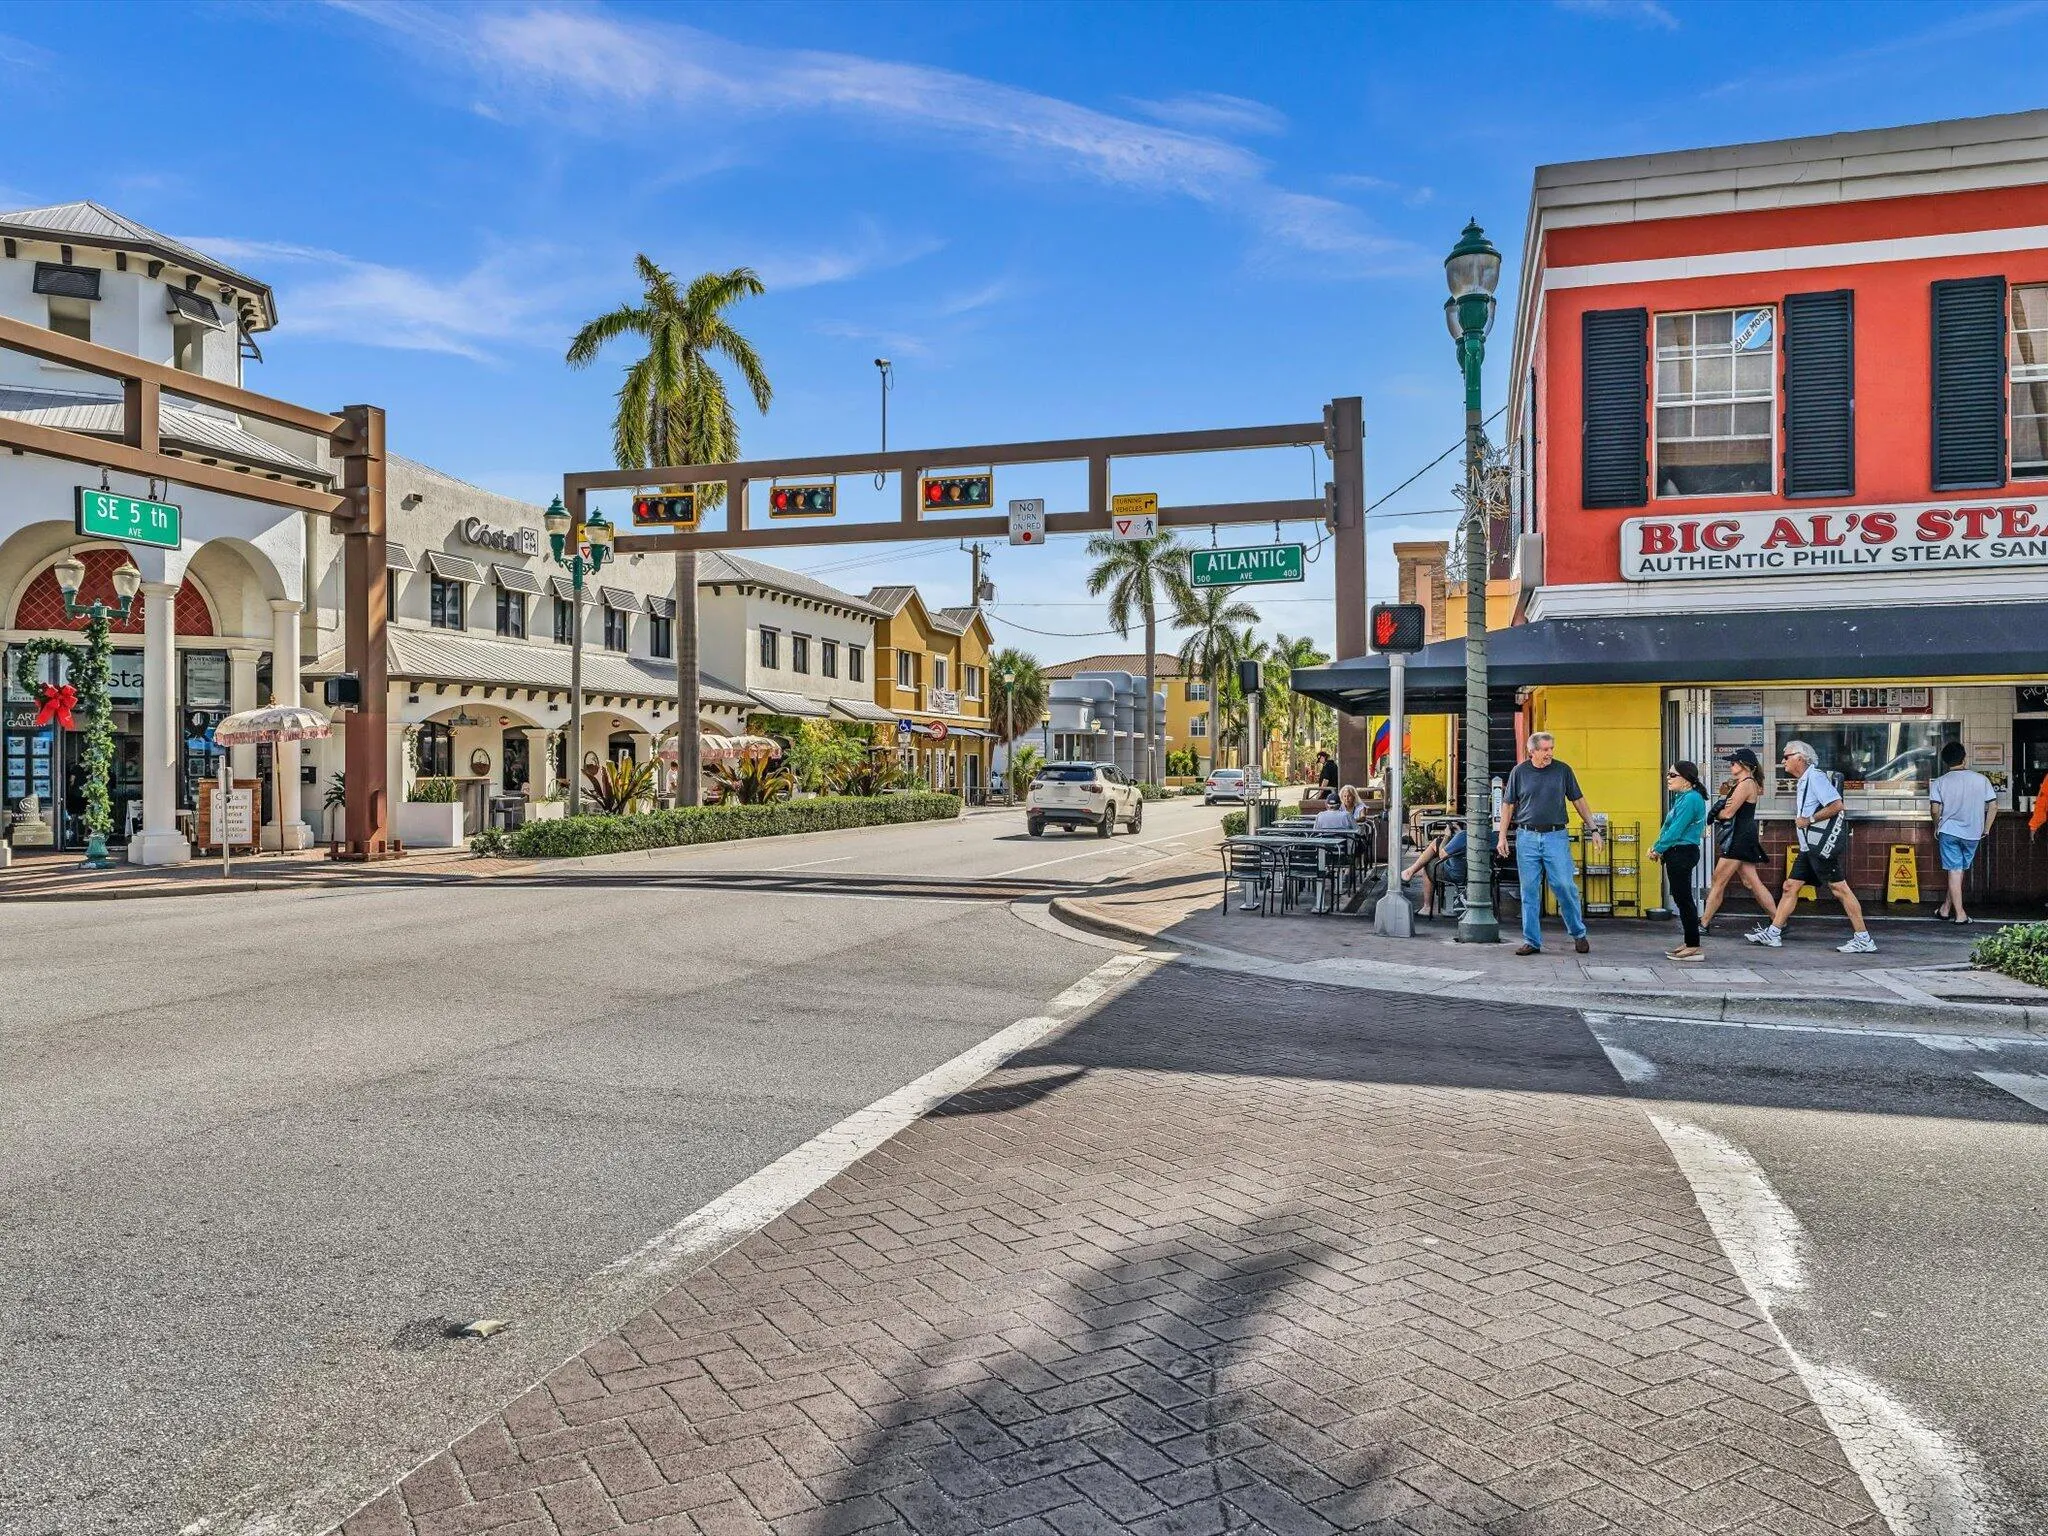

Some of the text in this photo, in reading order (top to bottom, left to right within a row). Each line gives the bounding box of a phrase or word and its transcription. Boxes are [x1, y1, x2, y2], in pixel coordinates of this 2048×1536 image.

[1749, 311, 1770, 332] MOON
[1019, 503, 1034, 512] NO
[1115, 505, 1143, 513] VEHICLES
[1116, 498, 1142, 506] TURNING
[97, 497, 167, 528] SE 5 th
[128, 528, 142, 538] AVE
[1027, 522, 1041, 530] RED
[1640, 504, 2048, 554] BIG AL'S STE
[1208, 550, 1286, 571] ATLANTIC
[1639, 541, 2047, 573] AUTHENTIC PHILLY STEAK SAN
[1196, 569, 1297, 583] 500 AVE 400
